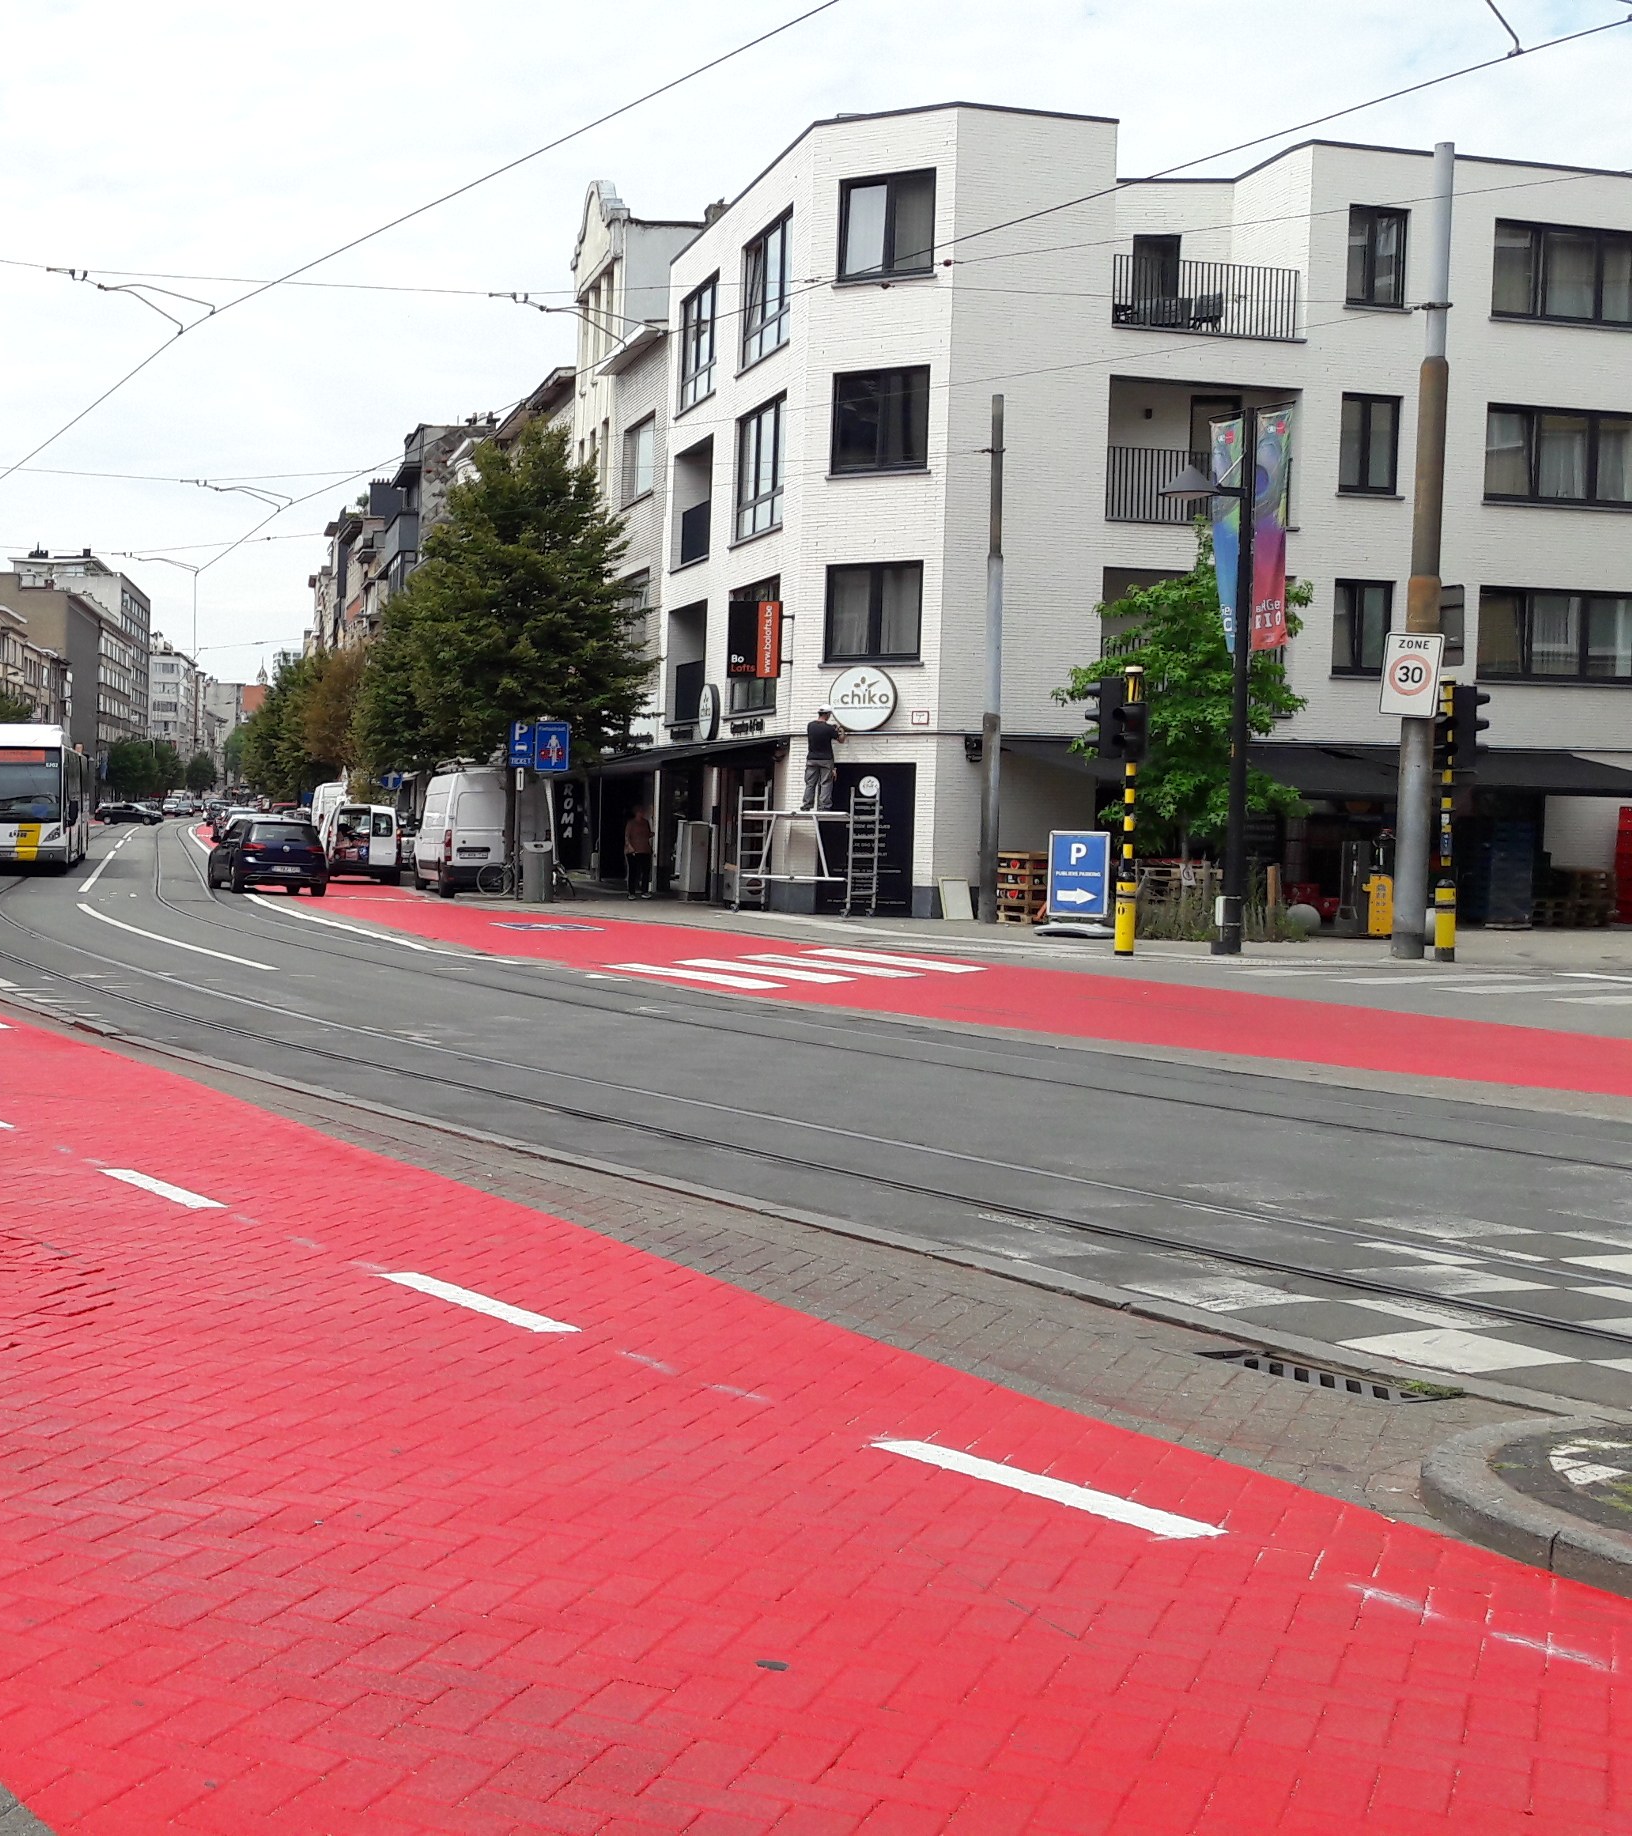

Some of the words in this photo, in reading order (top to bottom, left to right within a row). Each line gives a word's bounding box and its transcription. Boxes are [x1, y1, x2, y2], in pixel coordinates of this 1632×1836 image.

[763, 605, 773, 674] www.bolofts.be
[1398, 640, 1430, 650] ZONE
[731, 654, 744, 663] Bo
[731, 664, 756, 673] Lofts
[1398, 665, 1423, 683] 30
[840, 689, 889, 705] chiko
[515, 721, 528, 740] P
[561, 783, 574, 838] ROMA
[1070, 843, 1087, 865] P
